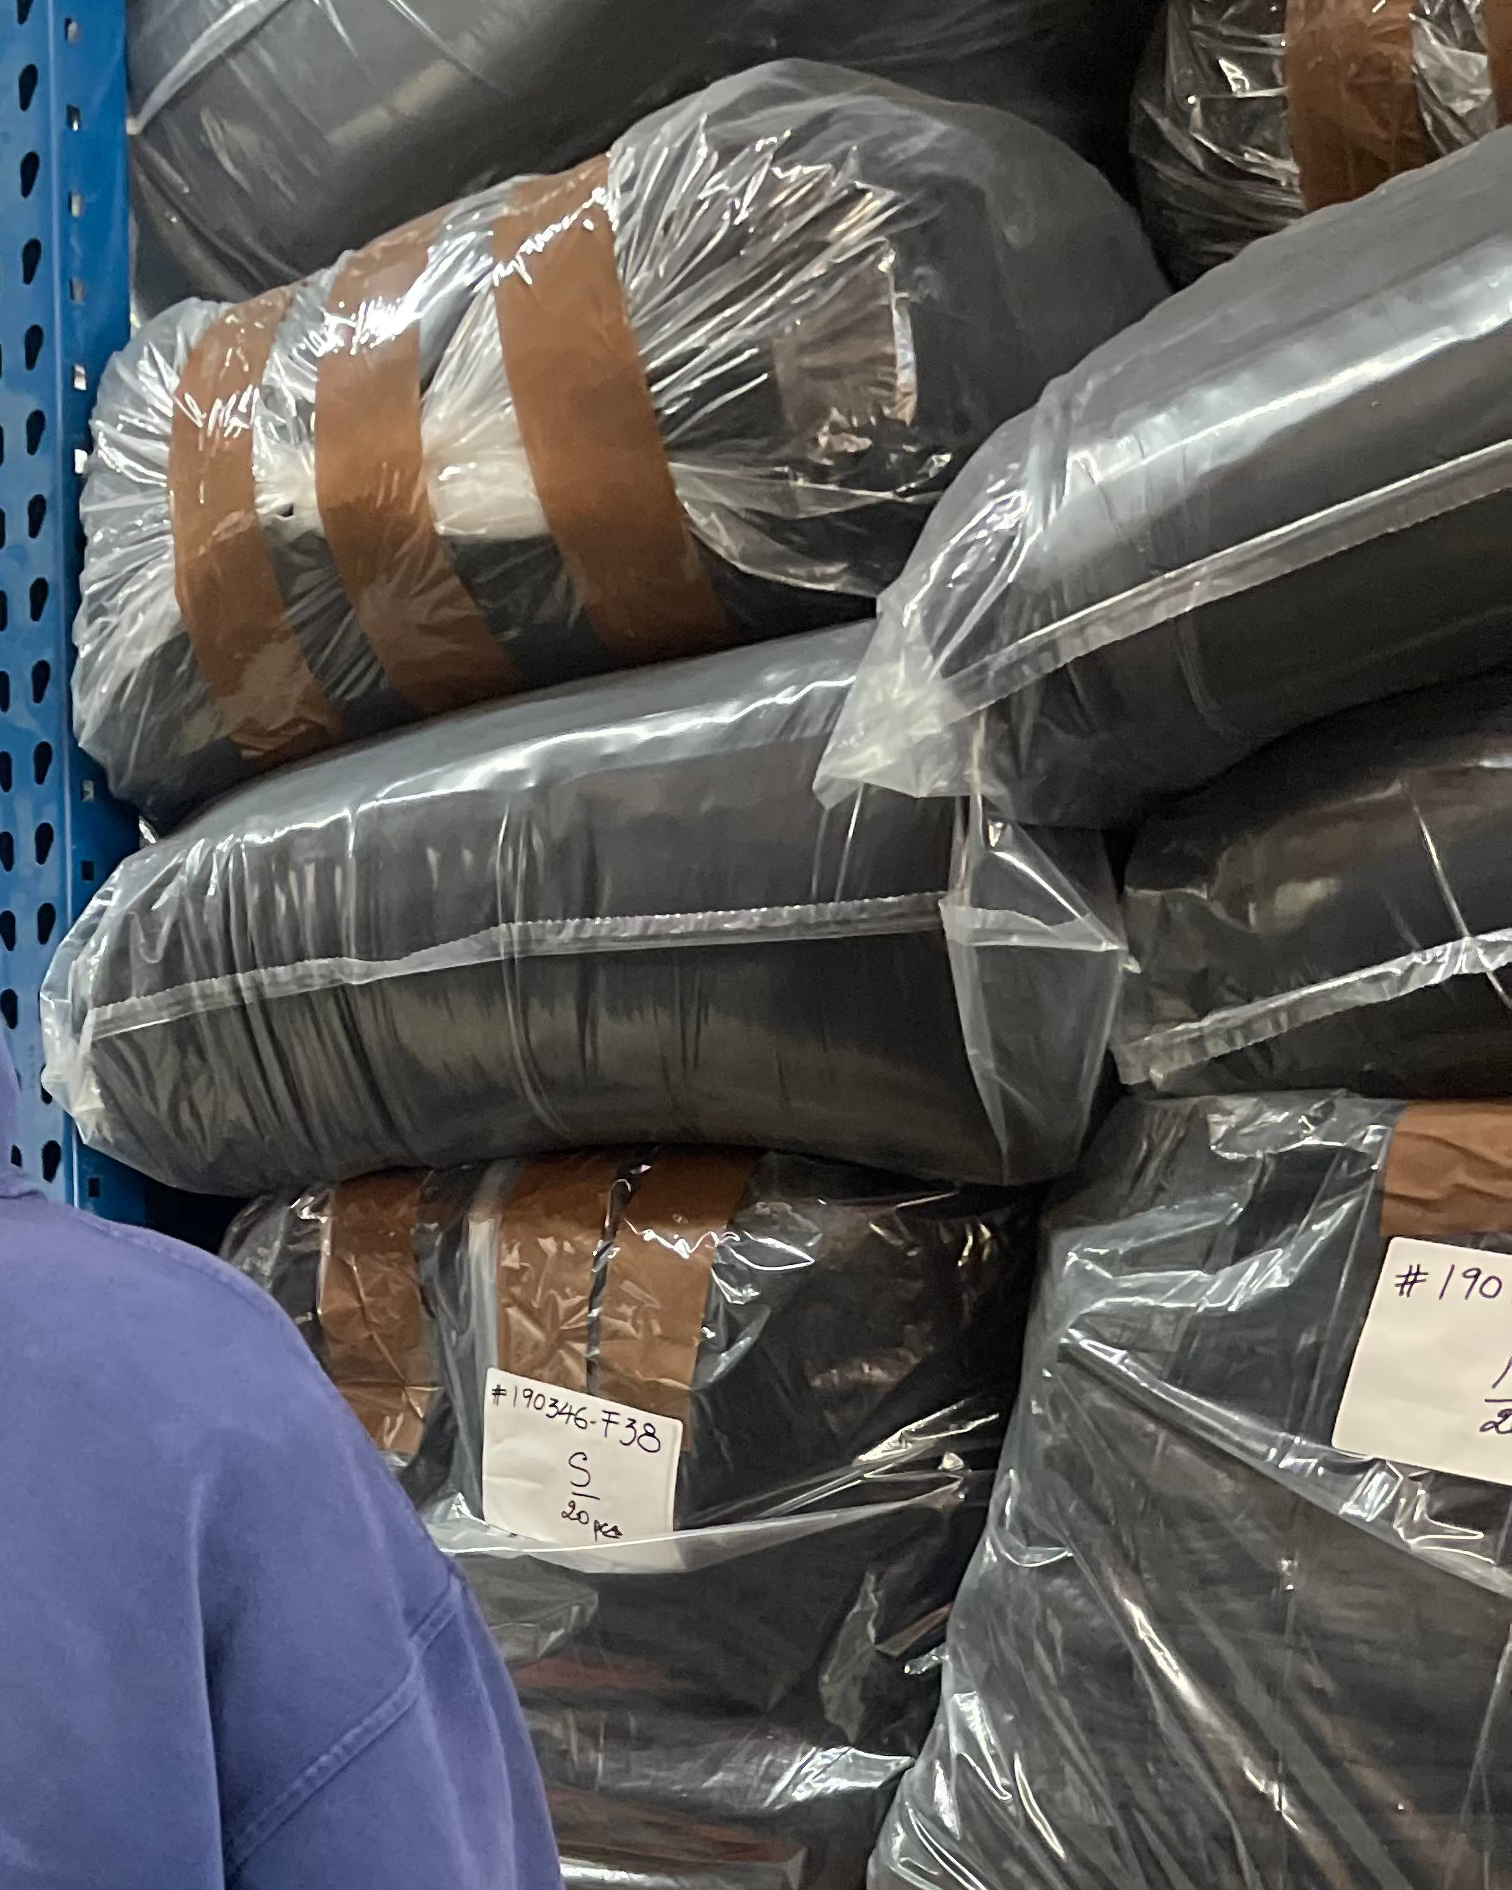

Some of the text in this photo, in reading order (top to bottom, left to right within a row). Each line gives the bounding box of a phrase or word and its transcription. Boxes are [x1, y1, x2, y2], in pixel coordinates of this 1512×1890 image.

[491, 1384, 661, 1453] #190346-F38
[568, 1451, 592, 1488] S
[561, 1500, 589, 1525] 20
